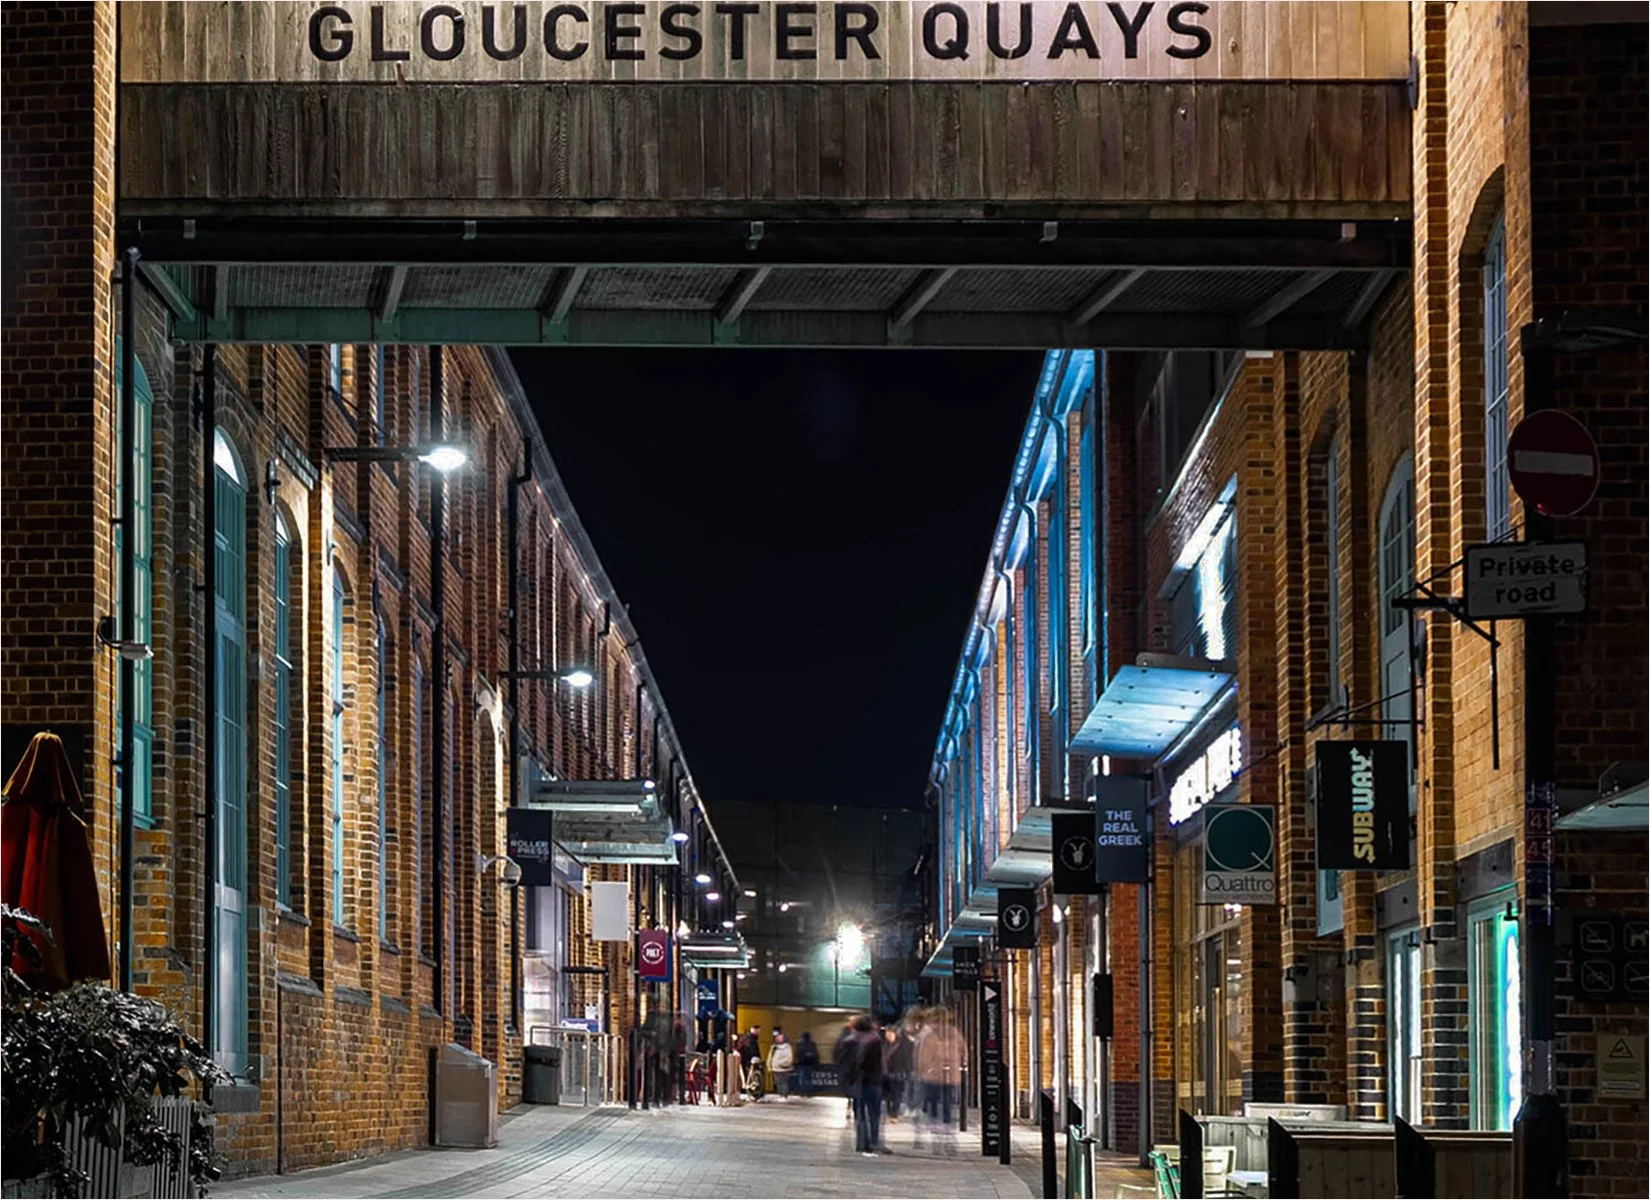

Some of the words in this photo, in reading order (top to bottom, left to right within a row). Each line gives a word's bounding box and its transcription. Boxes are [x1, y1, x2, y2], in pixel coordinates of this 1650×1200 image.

[308, 3, 881, 62] GLOUCESTER
[922, 1, 1213, 61] QUAYS
[1480, 554, 1575, 577] Private
[1495, 581, 1556, 603] road
[1348, 747, 1376, 864] SUBWAY
[1105, 810, 1132, 821] THE
[1103, 822, 1139, 833] REAL
[510, 840, 549, 848] ROLLER
[1098, 835, 1142, 846] GREEK
[517, 847, 549, 856] PRESS
[1205, 873, 1275, 893] Quattro
